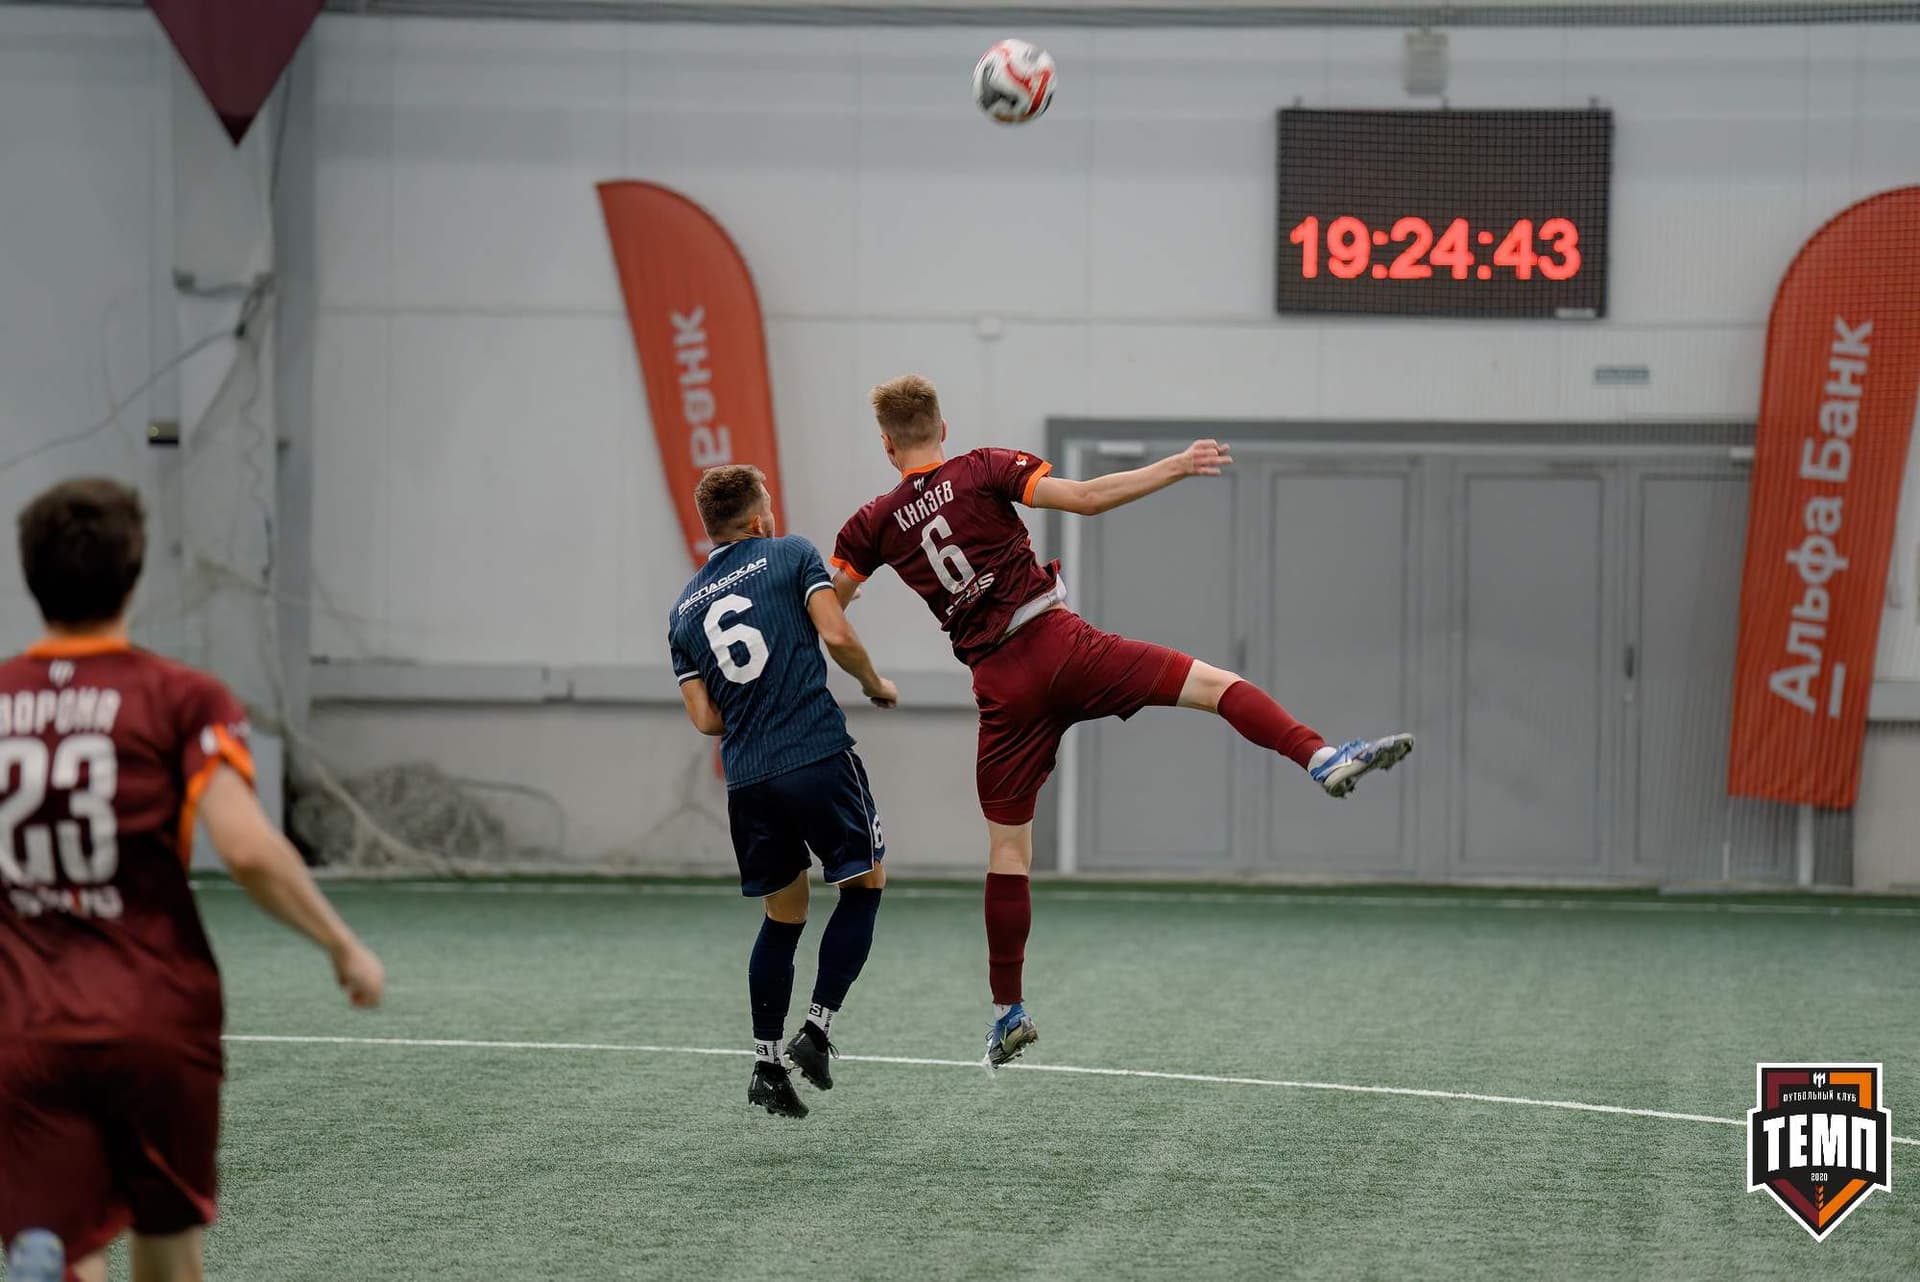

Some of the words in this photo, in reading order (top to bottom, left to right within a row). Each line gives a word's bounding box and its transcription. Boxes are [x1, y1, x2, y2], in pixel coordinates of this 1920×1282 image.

[1290, 216, 1581, 281] 19:24:43
[1798, 315, 1874, 483] Банк
[893, 479, 954, 532] КНЯЗЕВ
[921, 514, 976, 595] 6
[703, 593, 770, 685] 6
[1768, 495, 1849, 714] Альфа
[0, 734, 118, 884] 23
